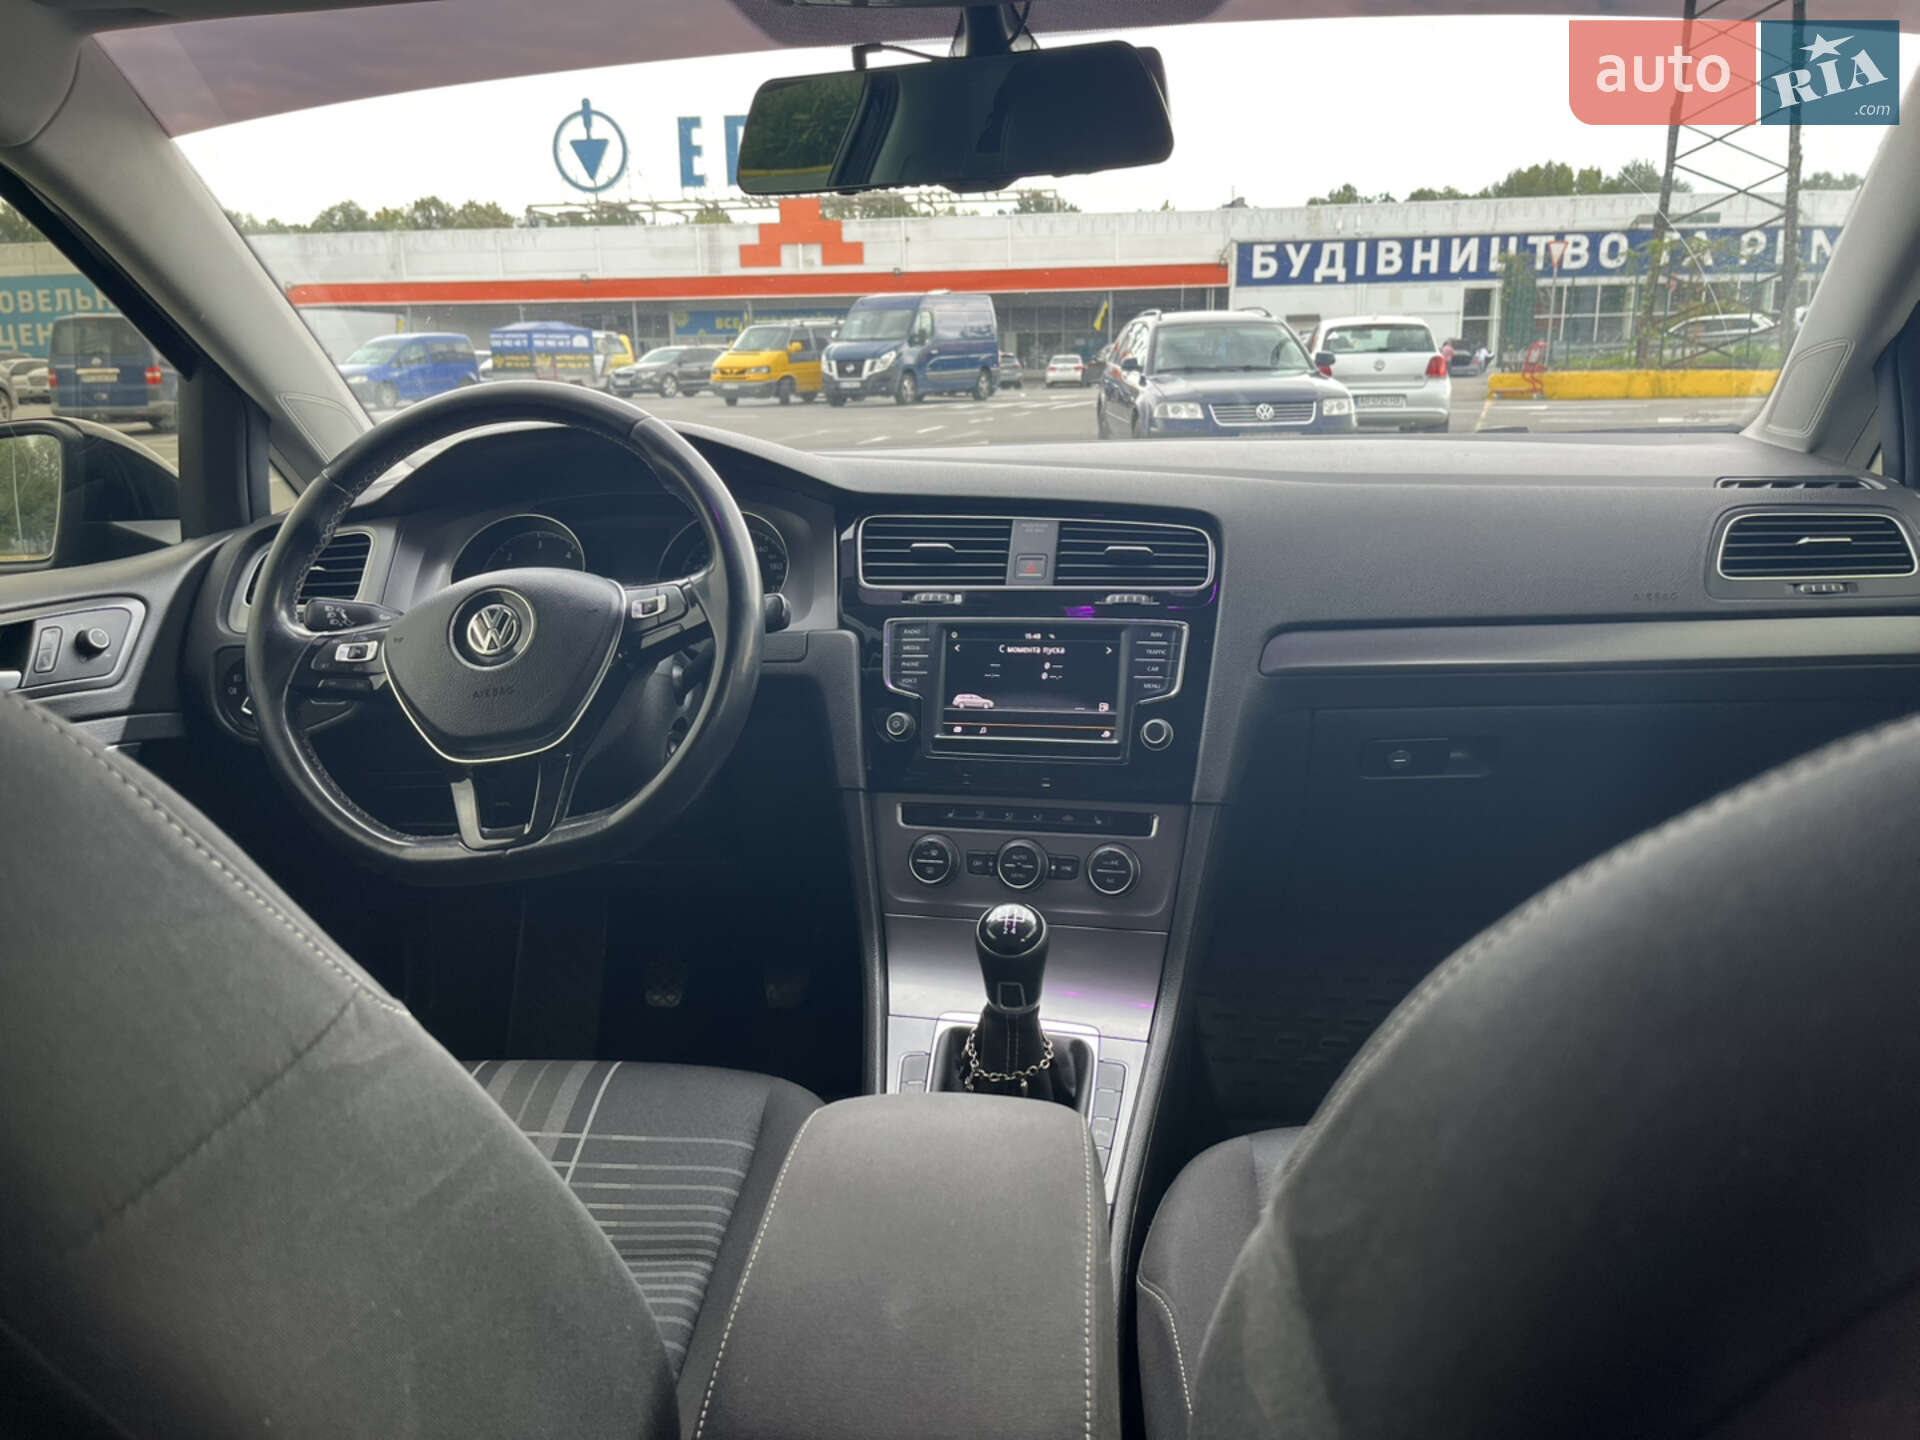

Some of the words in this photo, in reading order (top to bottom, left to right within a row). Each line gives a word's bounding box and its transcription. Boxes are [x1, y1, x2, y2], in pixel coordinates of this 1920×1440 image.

[1251, 231, 1629, 283] БУДІВНИЦТВО
[999, 644, 1006, 654] С
[1006, 645, 1041, 655] момента
[1042, 646, 1066, 656] пуска
